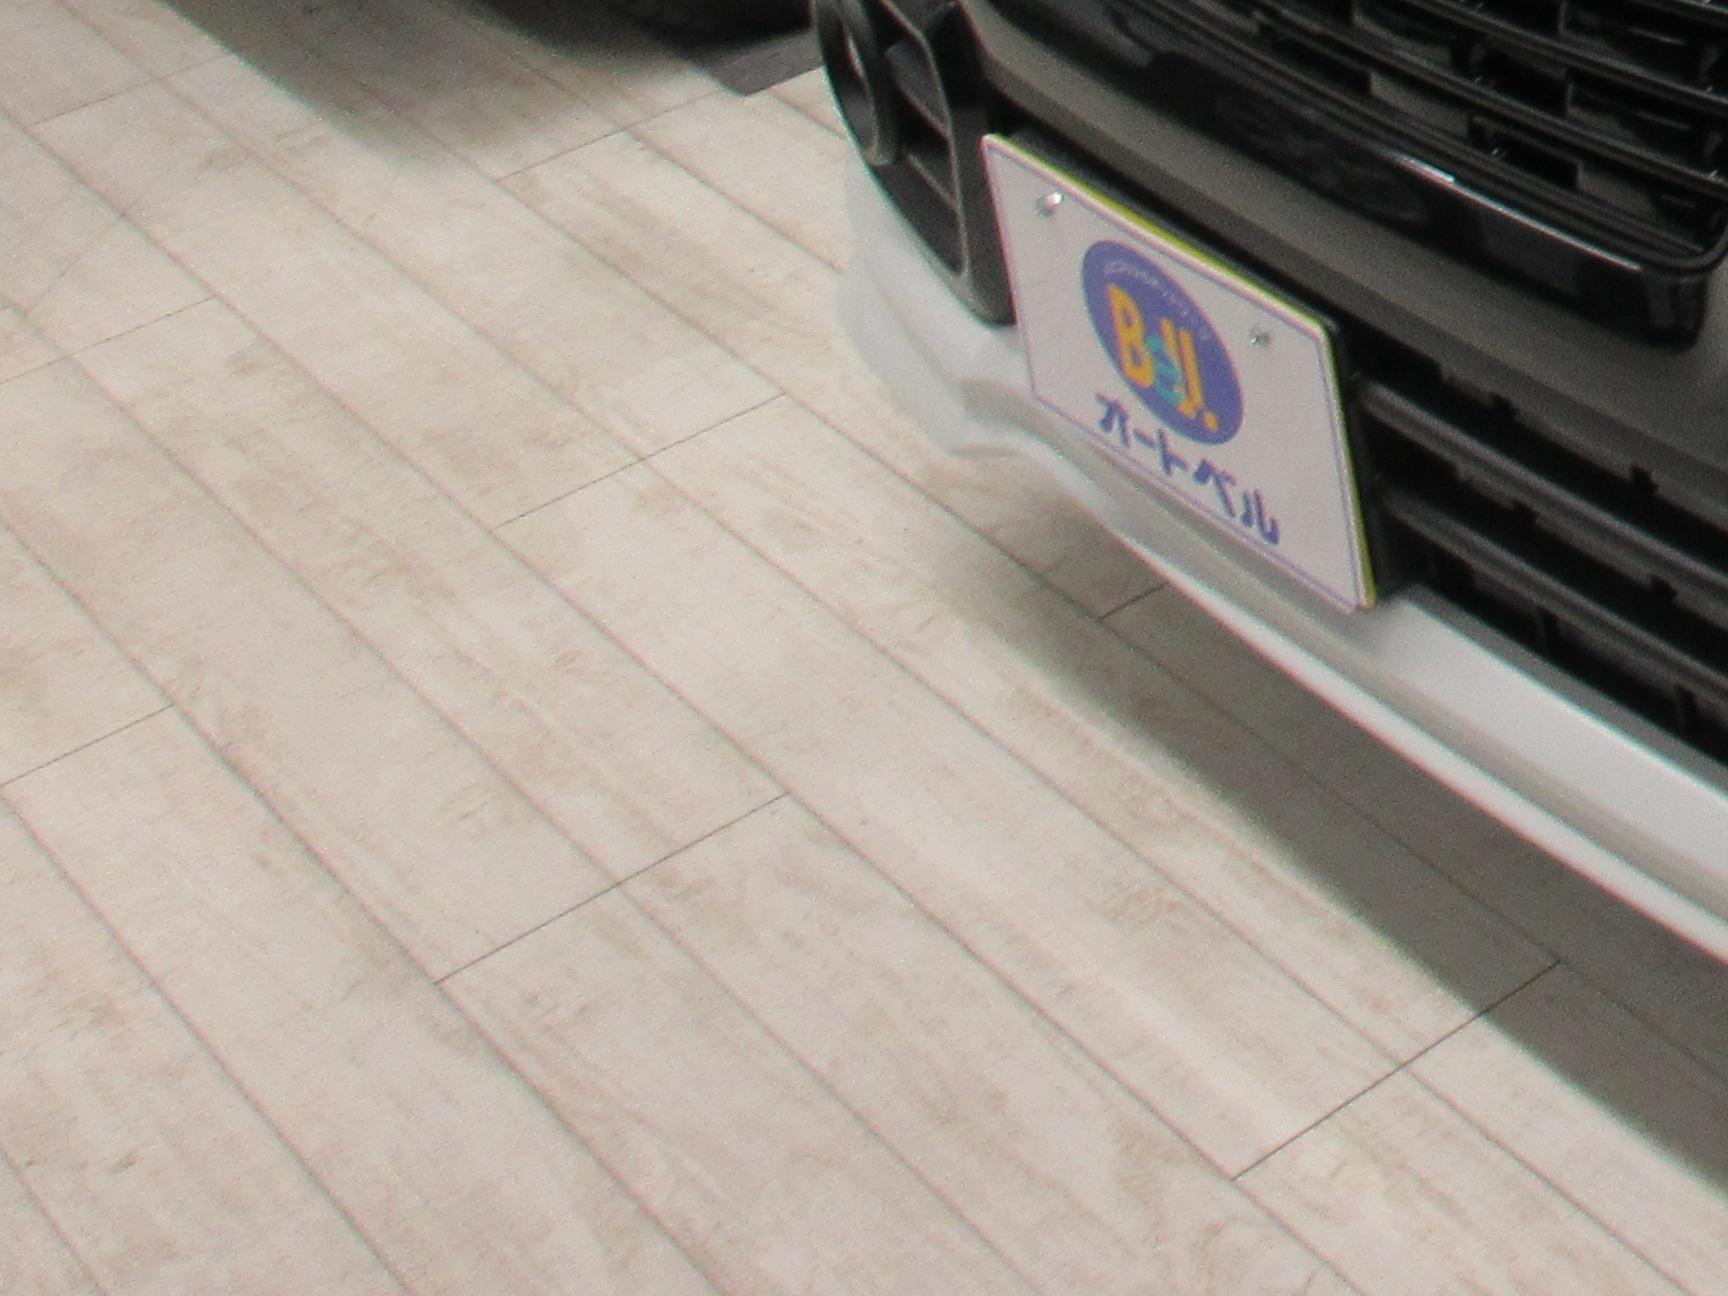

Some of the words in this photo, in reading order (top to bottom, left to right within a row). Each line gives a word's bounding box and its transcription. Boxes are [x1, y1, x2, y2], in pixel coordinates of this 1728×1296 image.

[1096, 391, 1280, 546] オートベル
